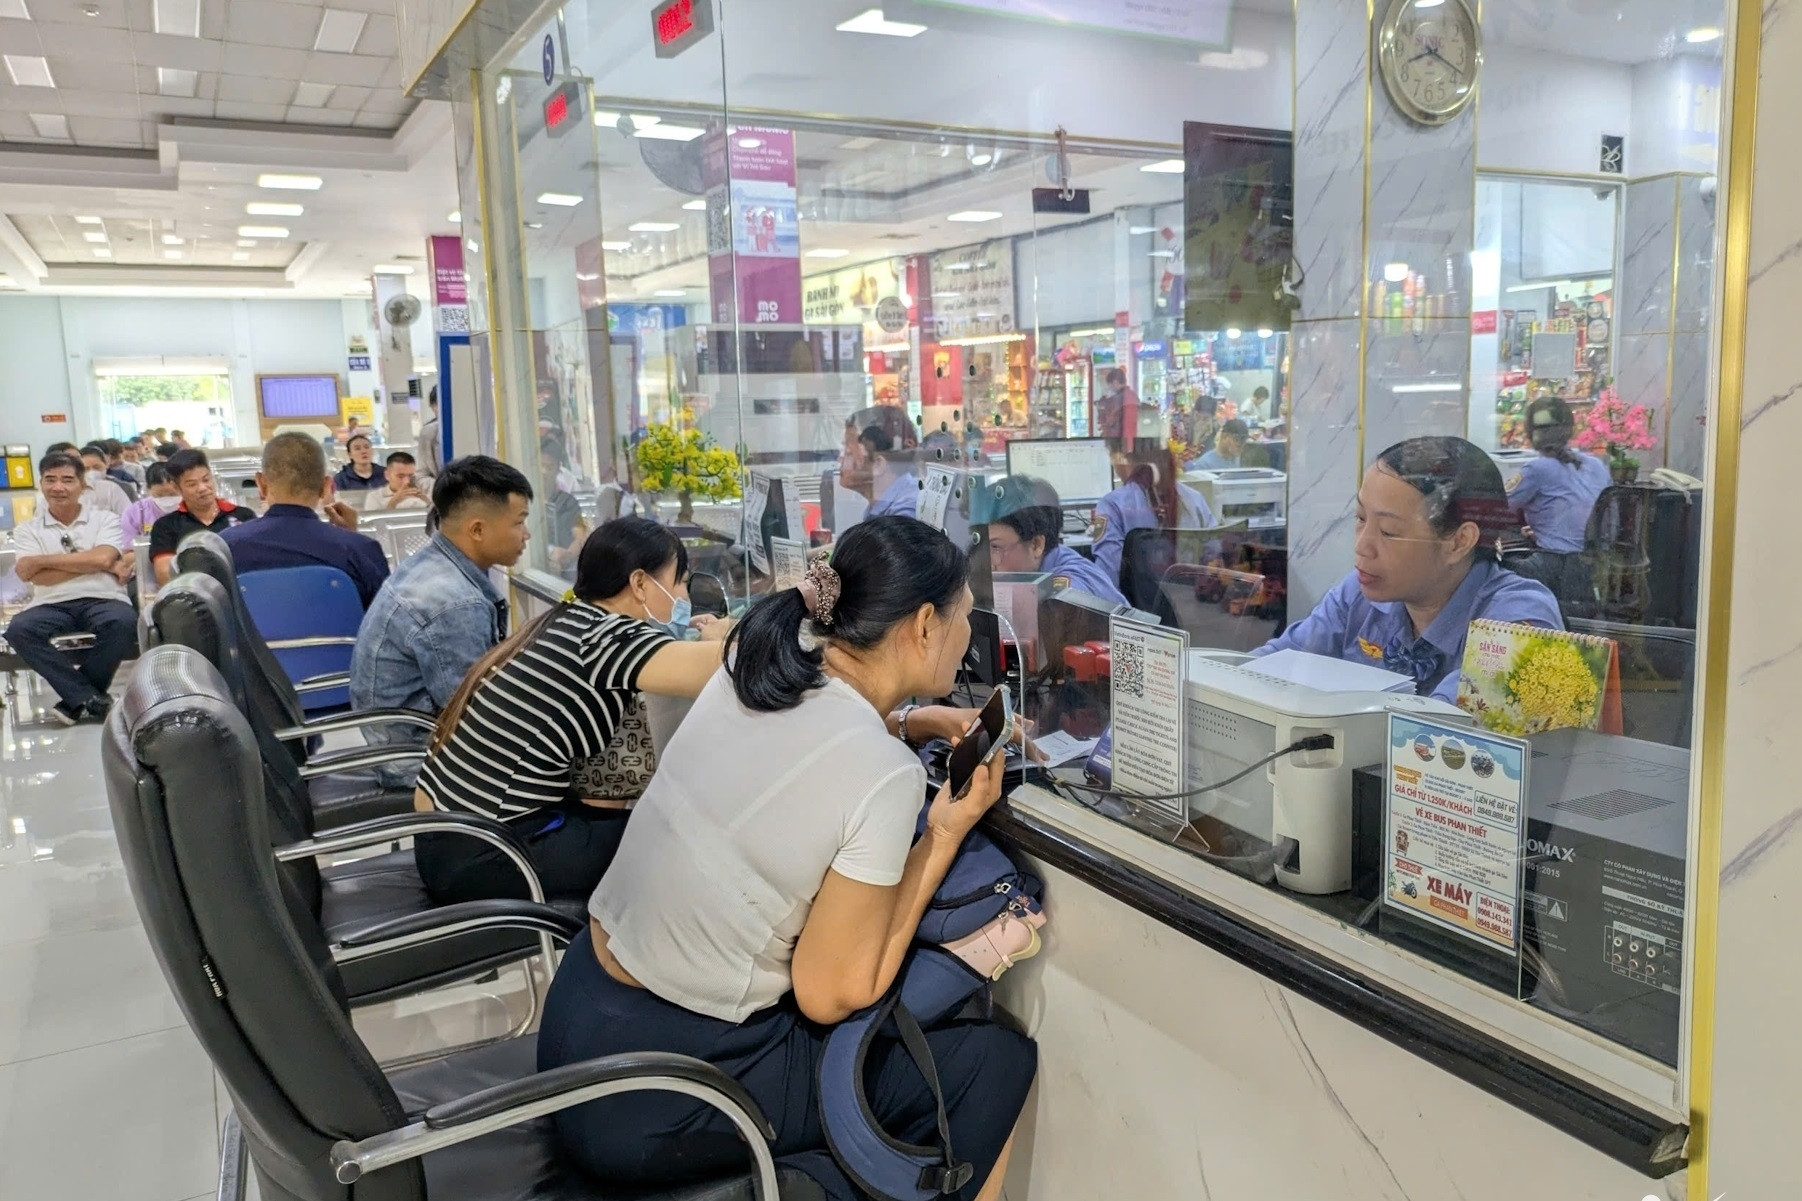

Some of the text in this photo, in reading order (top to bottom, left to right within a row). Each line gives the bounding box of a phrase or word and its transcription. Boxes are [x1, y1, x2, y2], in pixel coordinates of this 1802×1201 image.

[545, 37, 552, 80] 5
[1400, 63, 1409, 82] 8
[1414, 79, 1421, 98] 7
[1424, 83, 1433, 102] 6
[1437, 81, 1445, 100] 5
[1424, 811, 1433, 820] XE
[1434, 813, 1447, 825] BUS
[1448, 817, 1467, 832] PHAN
[1468, 824, 1488, 839] THIẾT
[1427, 875, 1473, 906] XE MÁY
